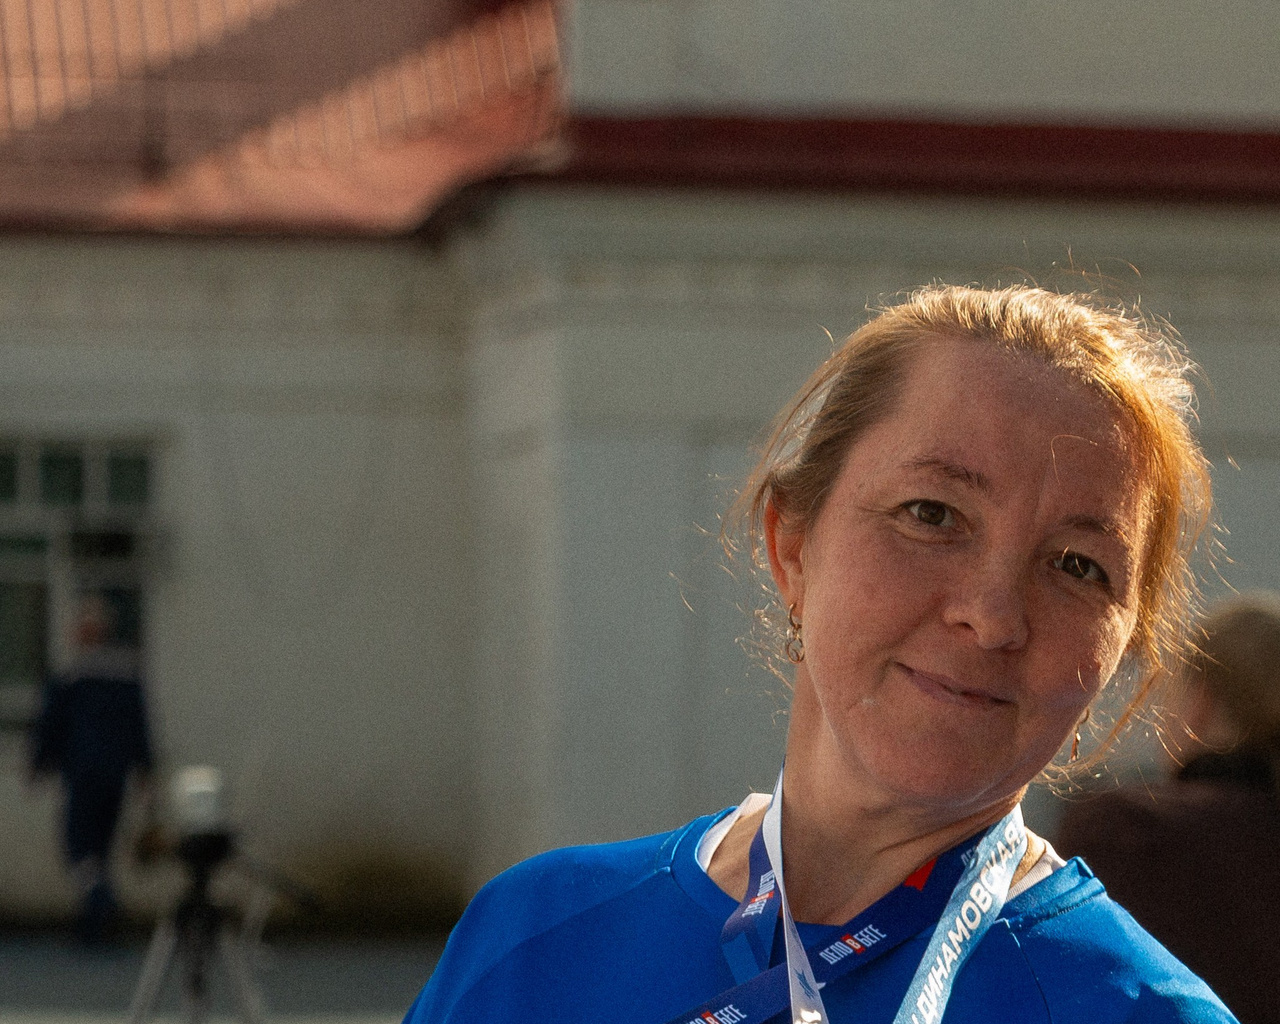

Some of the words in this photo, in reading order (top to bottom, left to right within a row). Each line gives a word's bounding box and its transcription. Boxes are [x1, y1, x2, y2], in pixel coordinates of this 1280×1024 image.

[819, 940, 854, 965] ДЕЛО
[845, 938, 861, 951] В
[853, 924, 888, 948] БЕГЕ
